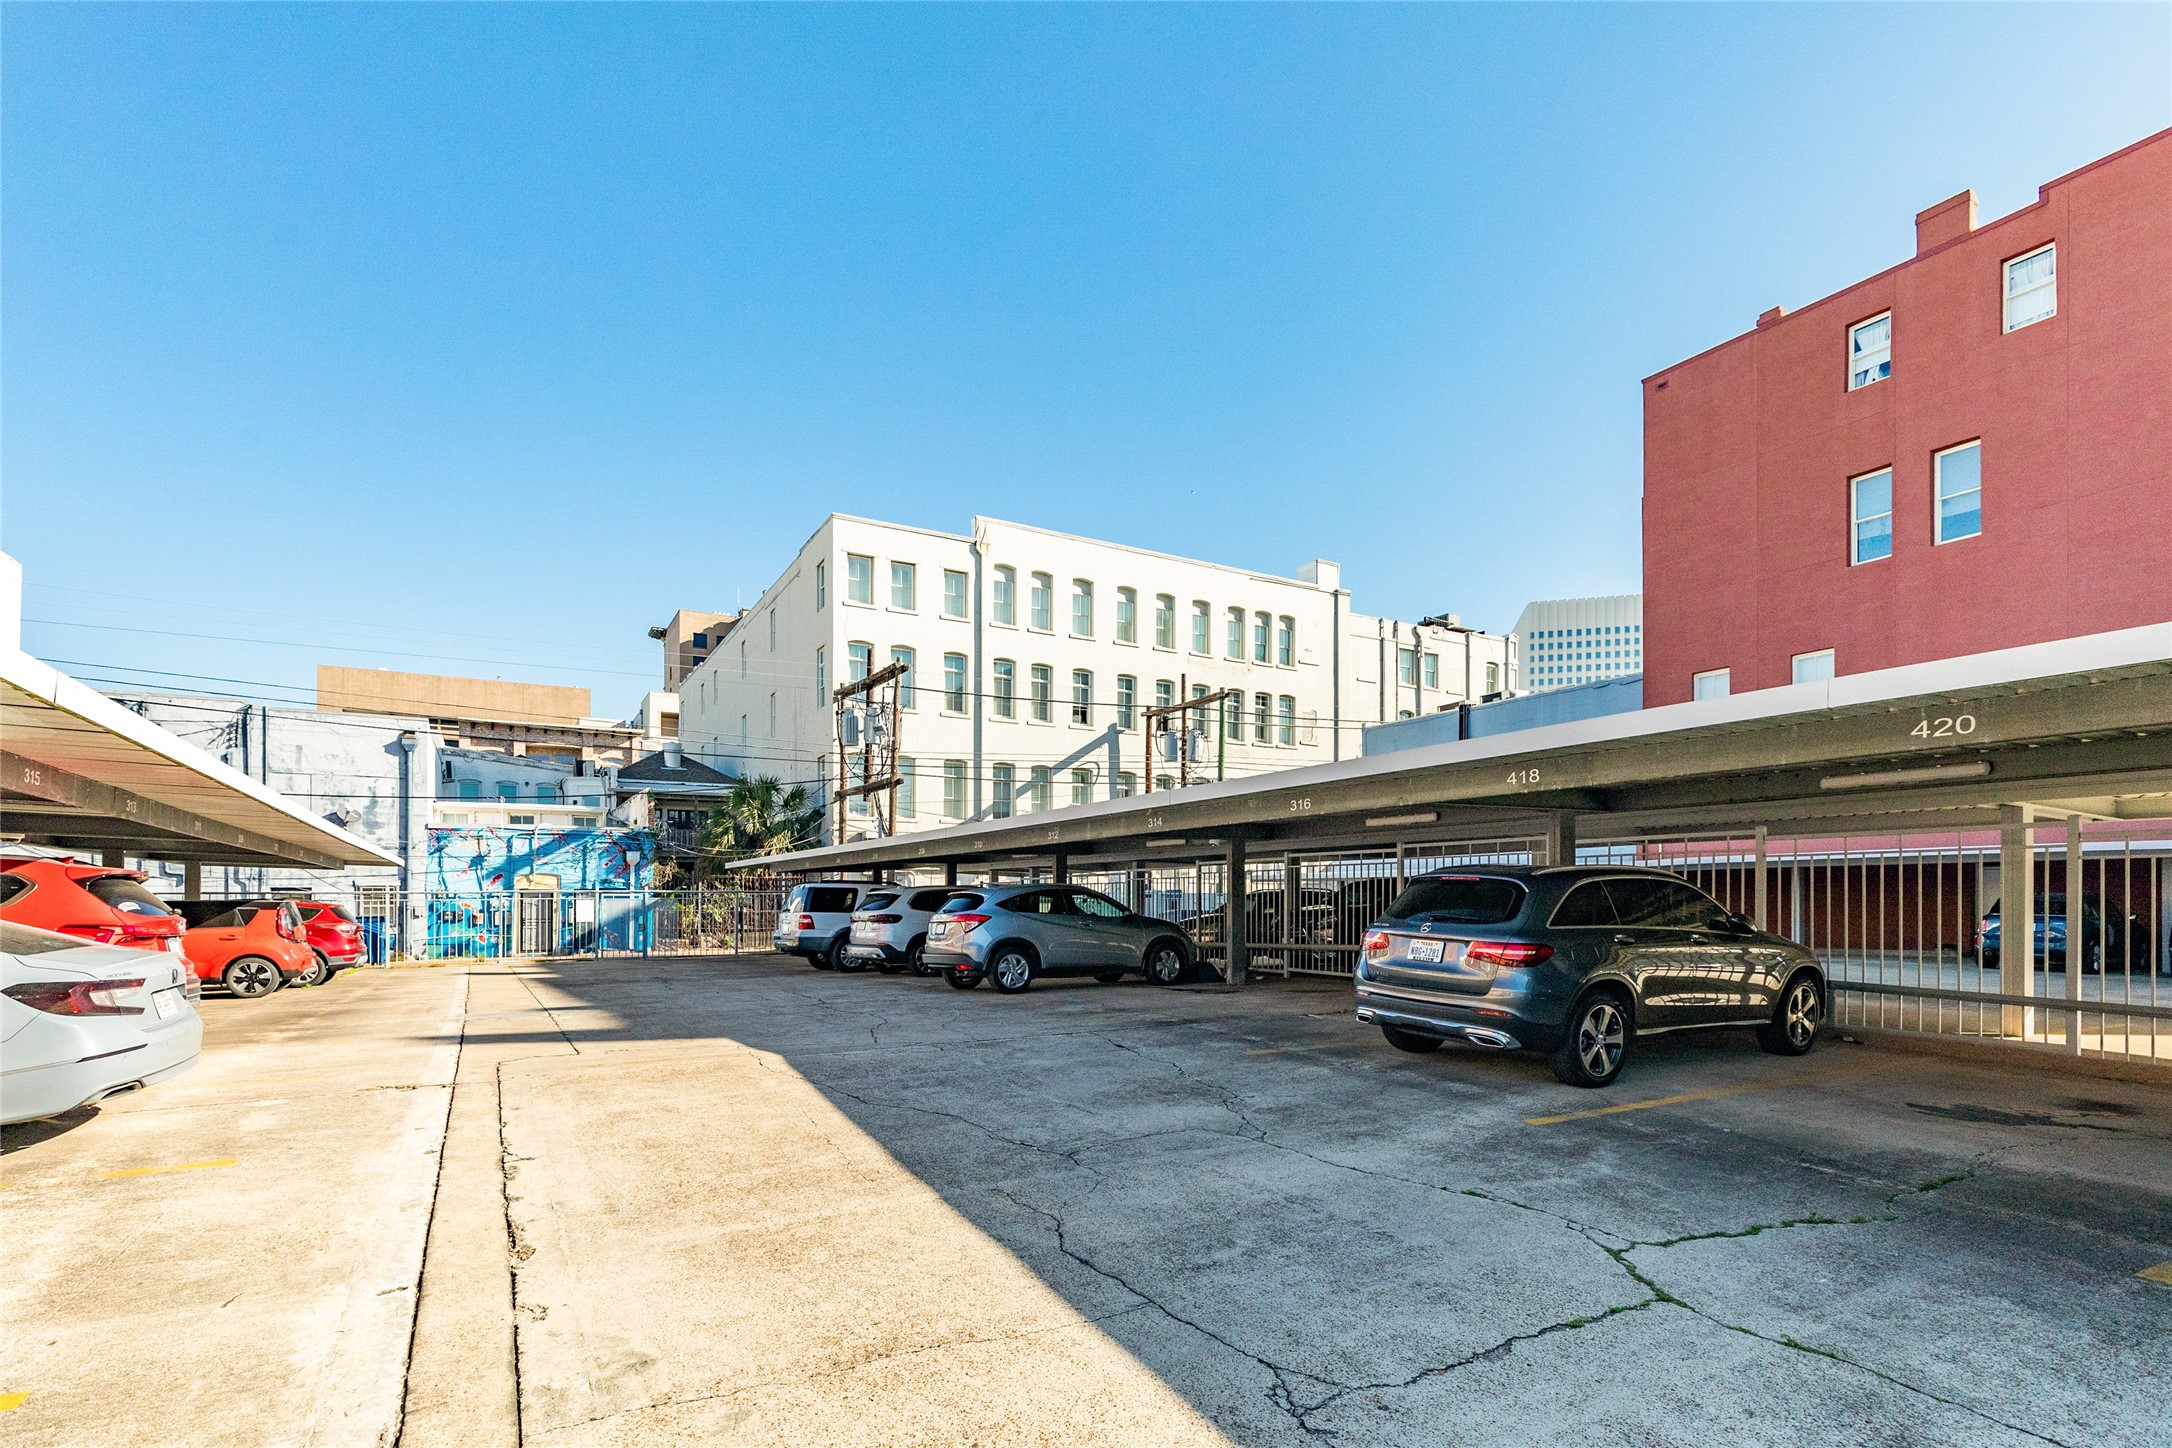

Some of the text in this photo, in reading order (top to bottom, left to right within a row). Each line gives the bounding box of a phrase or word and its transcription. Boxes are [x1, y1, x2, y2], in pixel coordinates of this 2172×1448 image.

[1910, 715, 1976, 738] 420
[24, 768, 41, 786] 315
[1506, 768, 1540, 785] 418
[126, 799, 137, 813] 313
[1290, 798, 1311, 811] 316
[1148, 817, 1163, 828] 314
[1048, 831, 1059, 840] 312
